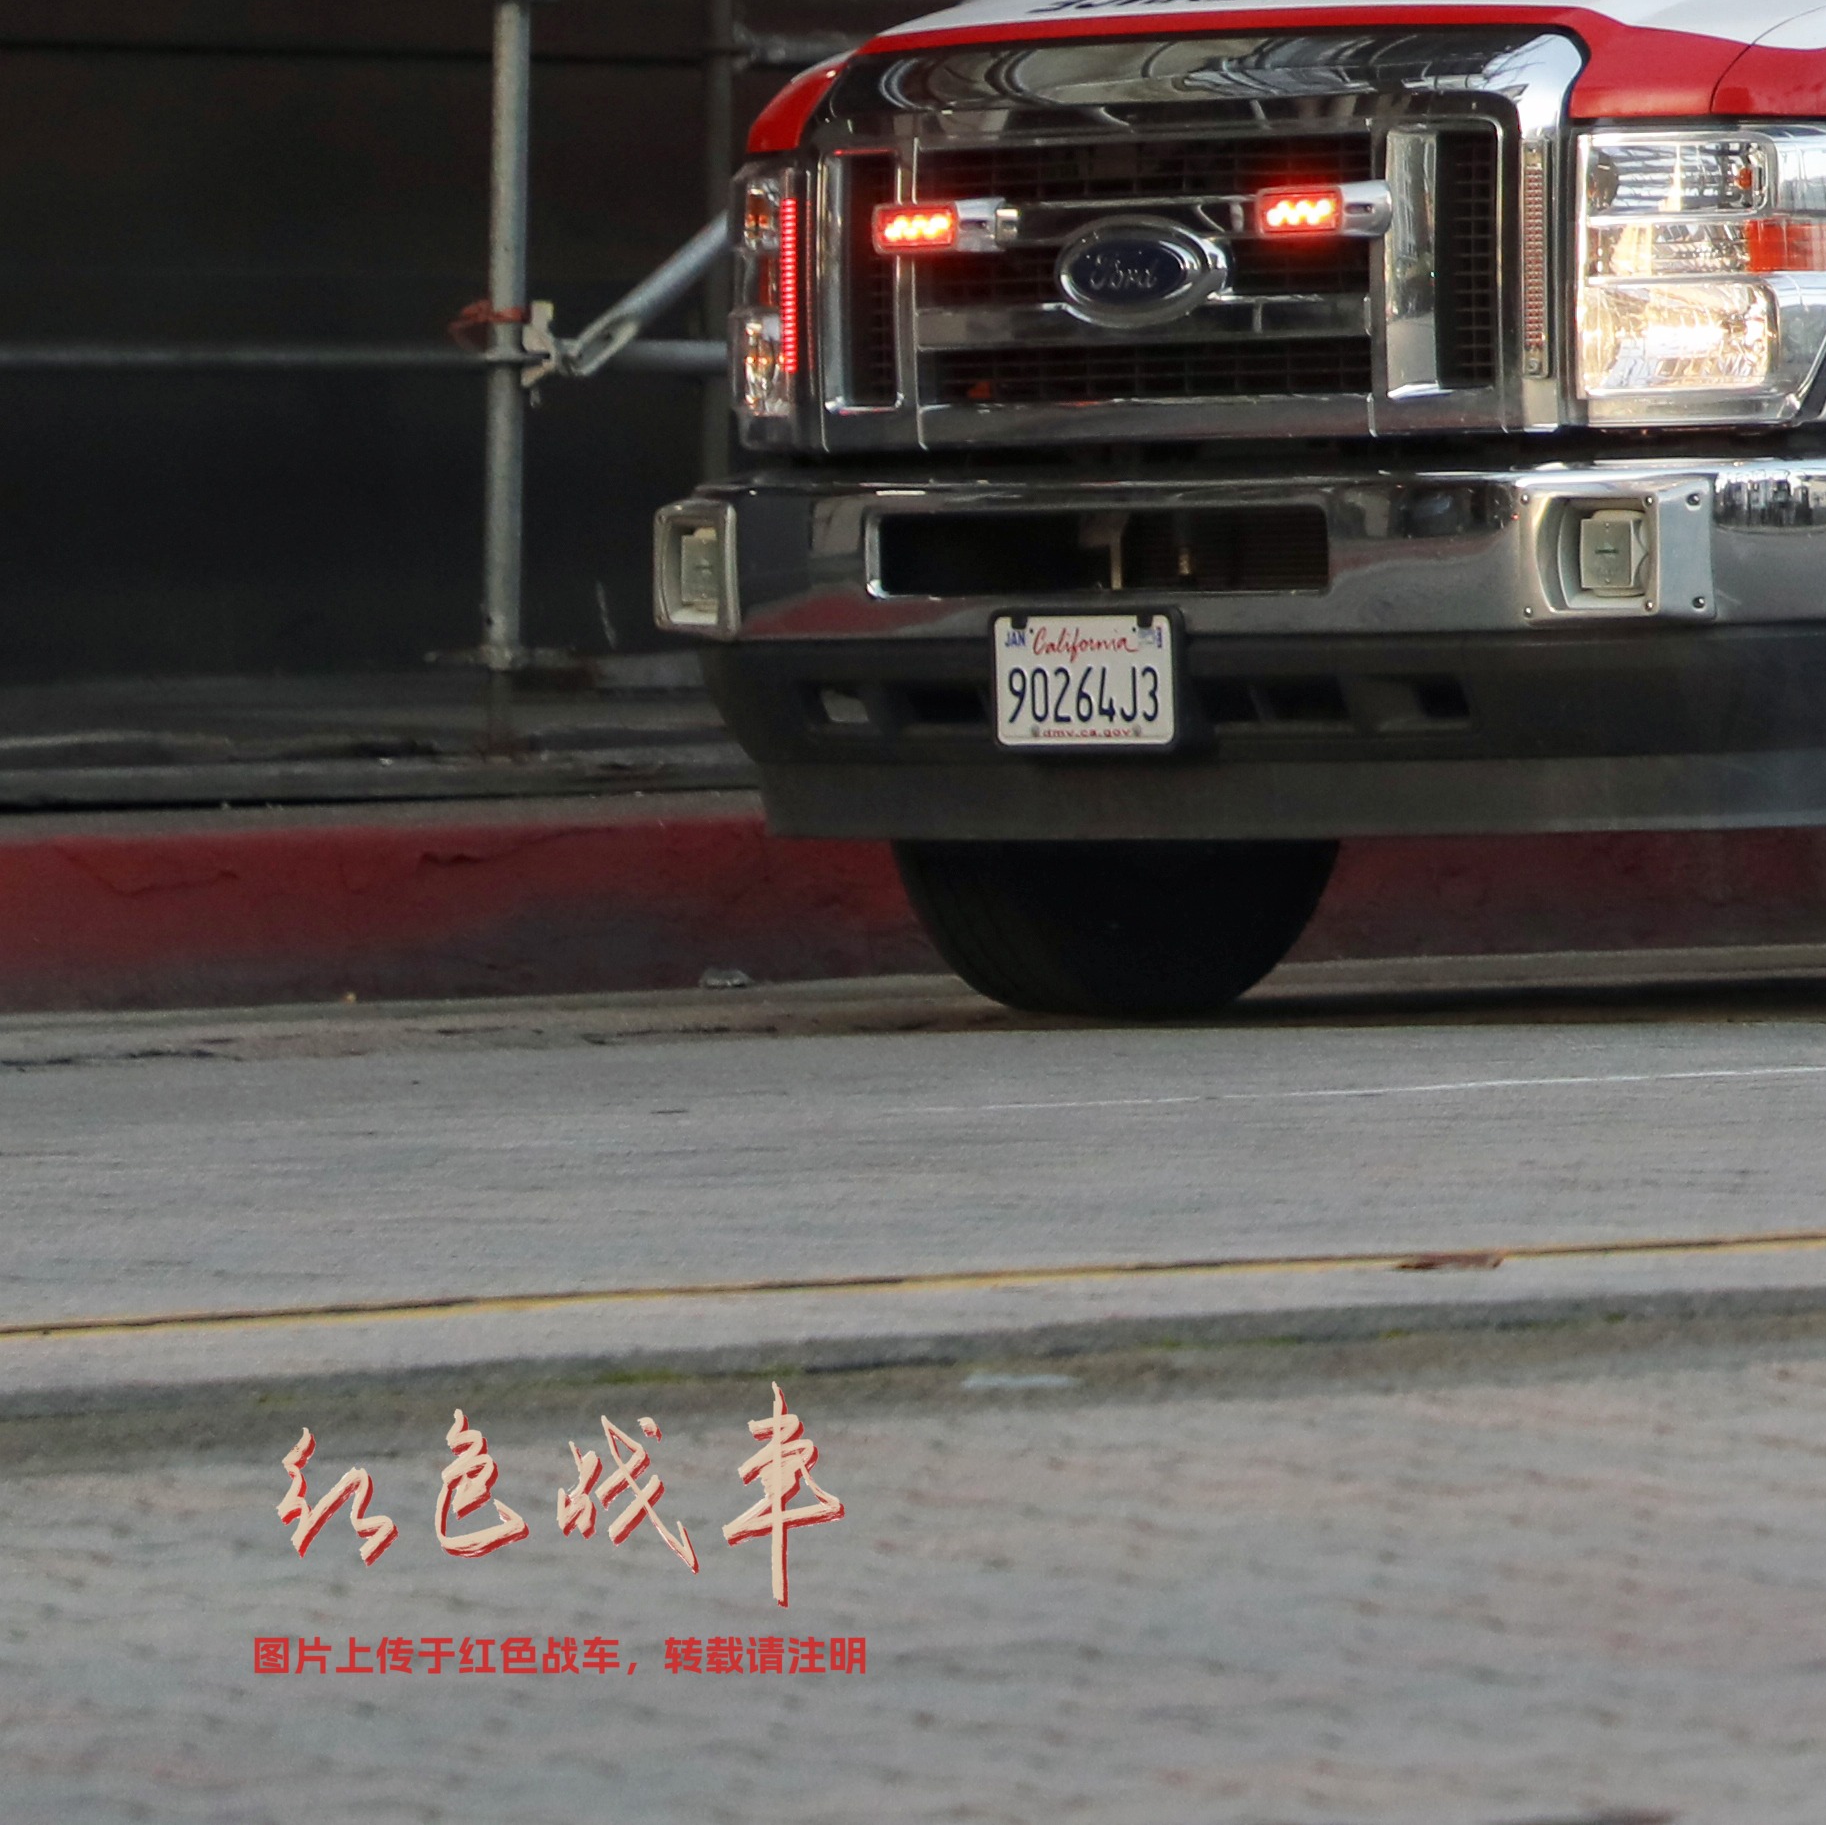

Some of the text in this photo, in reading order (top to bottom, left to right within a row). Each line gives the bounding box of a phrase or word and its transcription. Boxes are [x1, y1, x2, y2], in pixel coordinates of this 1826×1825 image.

[1005, 630, 1026, 647] JAN
[1033, 627, 1140, 662] California
[1008, 666, 1159, 723] 90264J3
[1043, 726, 1133, 738] dmv.ca.gov
